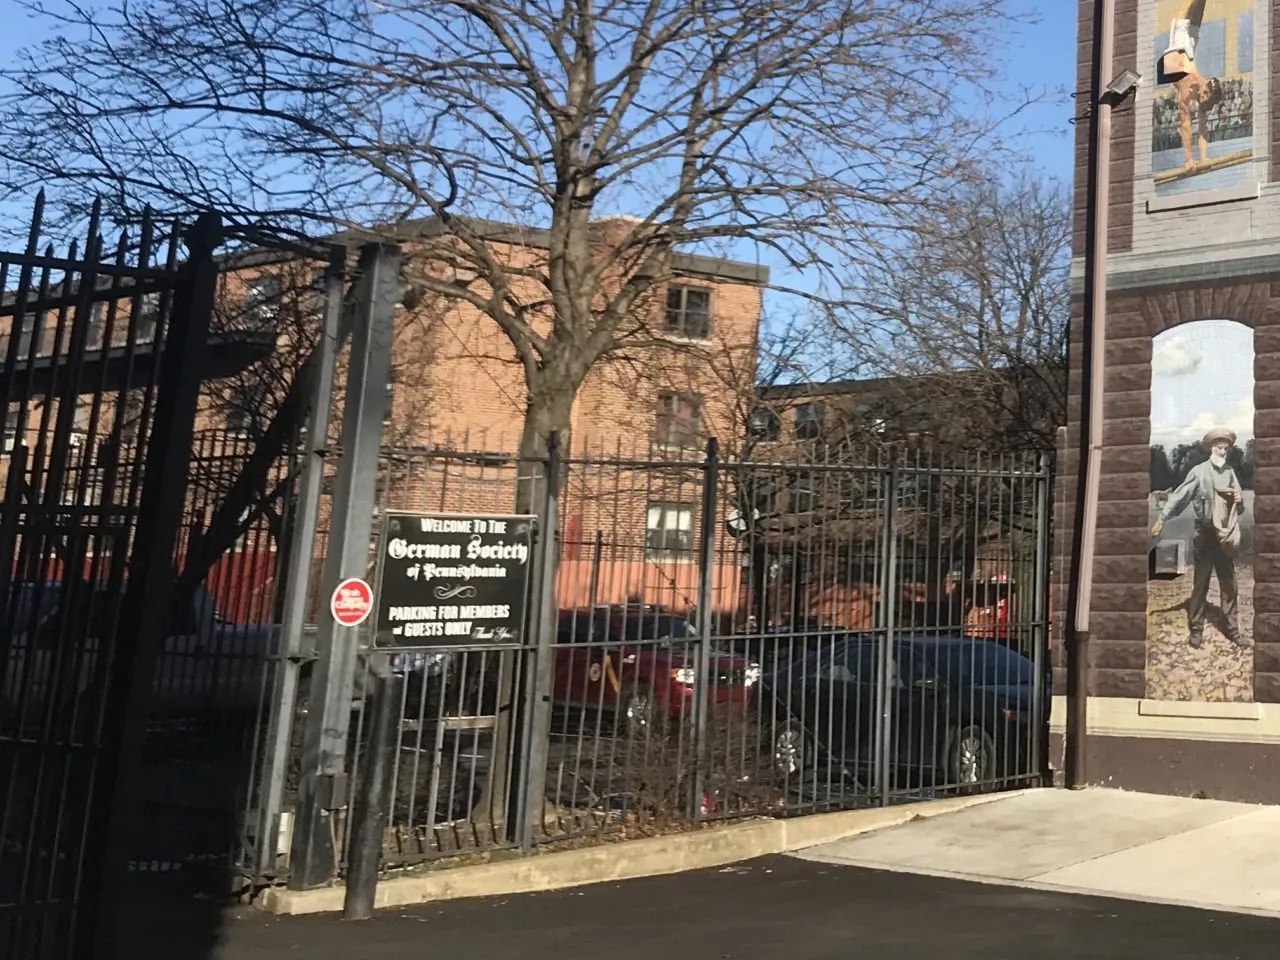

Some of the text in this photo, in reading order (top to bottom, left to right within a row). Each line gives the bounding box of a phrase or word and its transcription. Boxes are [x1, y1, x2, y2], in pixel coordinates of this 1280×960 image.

[421, 518, 507, 534] WELCOME TO THE
[388, 534, 528, 565] German Society
[406, 563, 507, 581] of Pennsylvania
[388, 605, 510, 620] PARKING FOR MEMBERS
[404, 622, 444, 637] GUESTS
[445, 622, 473, 636] ONLY
